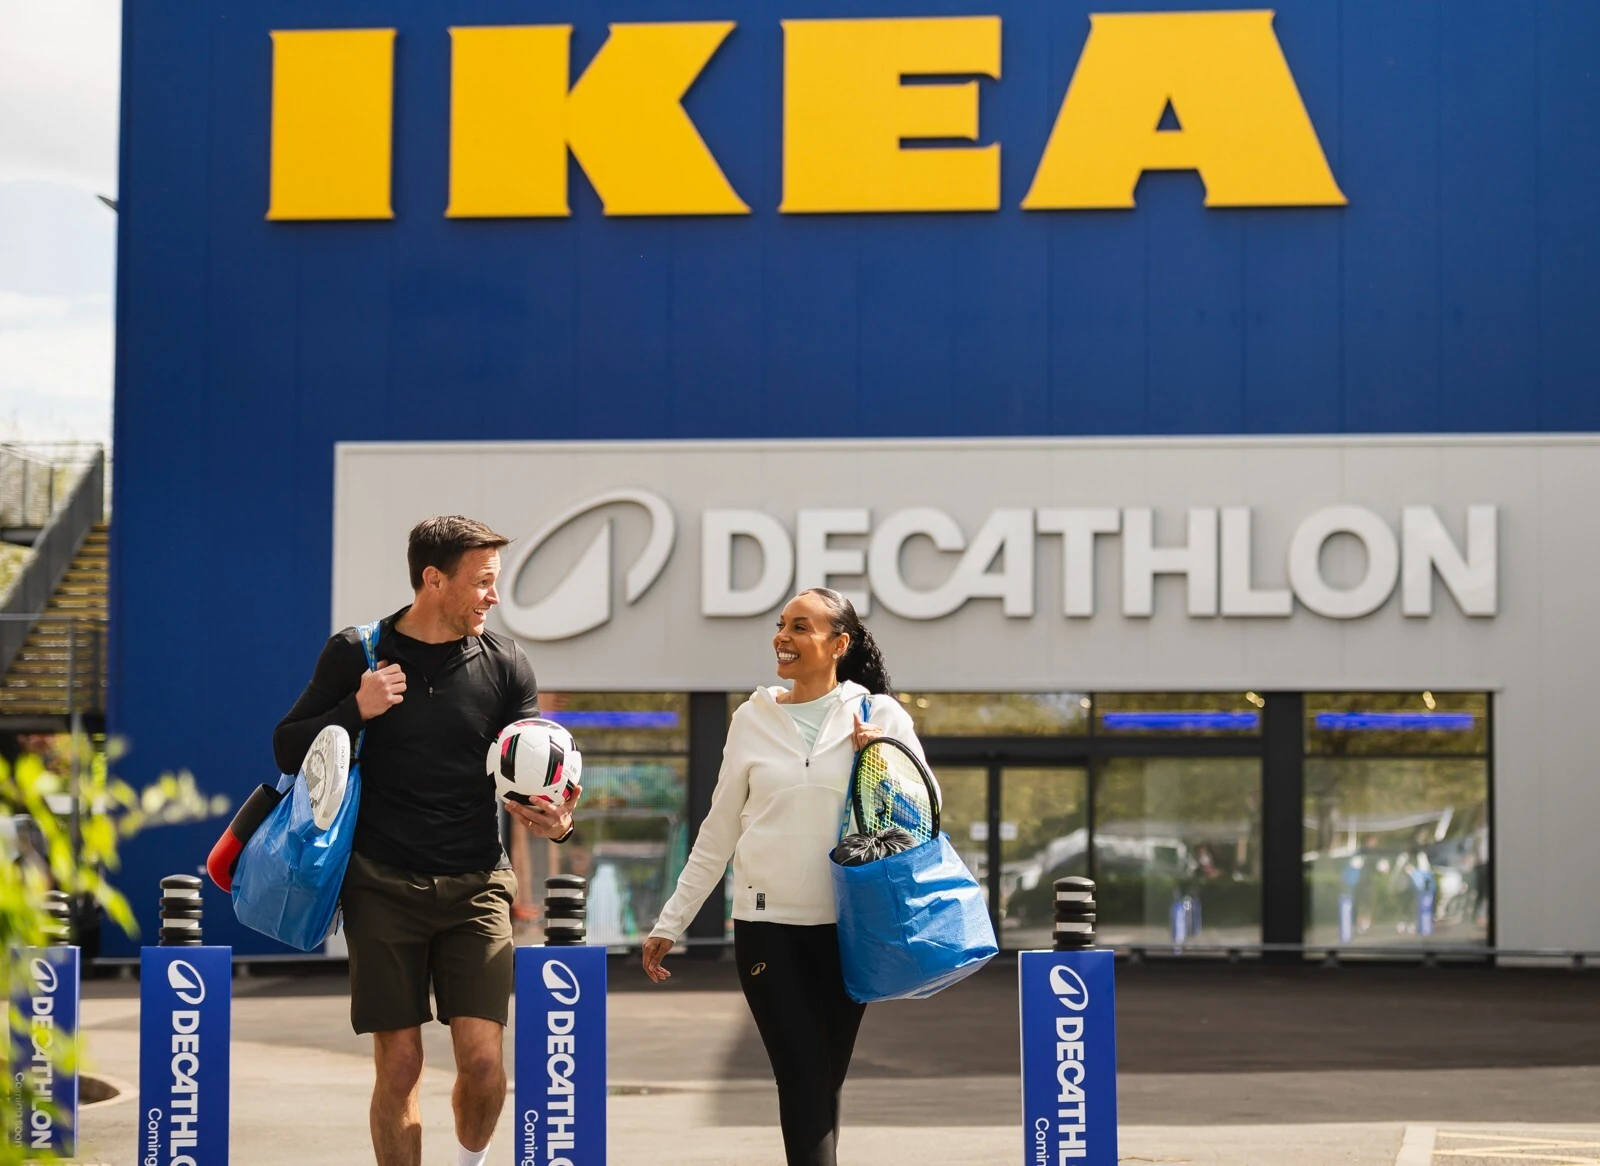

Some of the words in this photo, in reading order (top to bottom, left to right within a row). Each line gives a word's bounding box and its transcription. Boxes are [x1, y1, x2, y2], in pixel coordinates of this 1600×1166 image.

[265, 9, 1349, 220] IKEA
[701, 503, 1499, 620] DECATHLON
[31, 996, 54, 1148] DECATHLON
[1055, 1016, 1087, 1166] DECATHL
